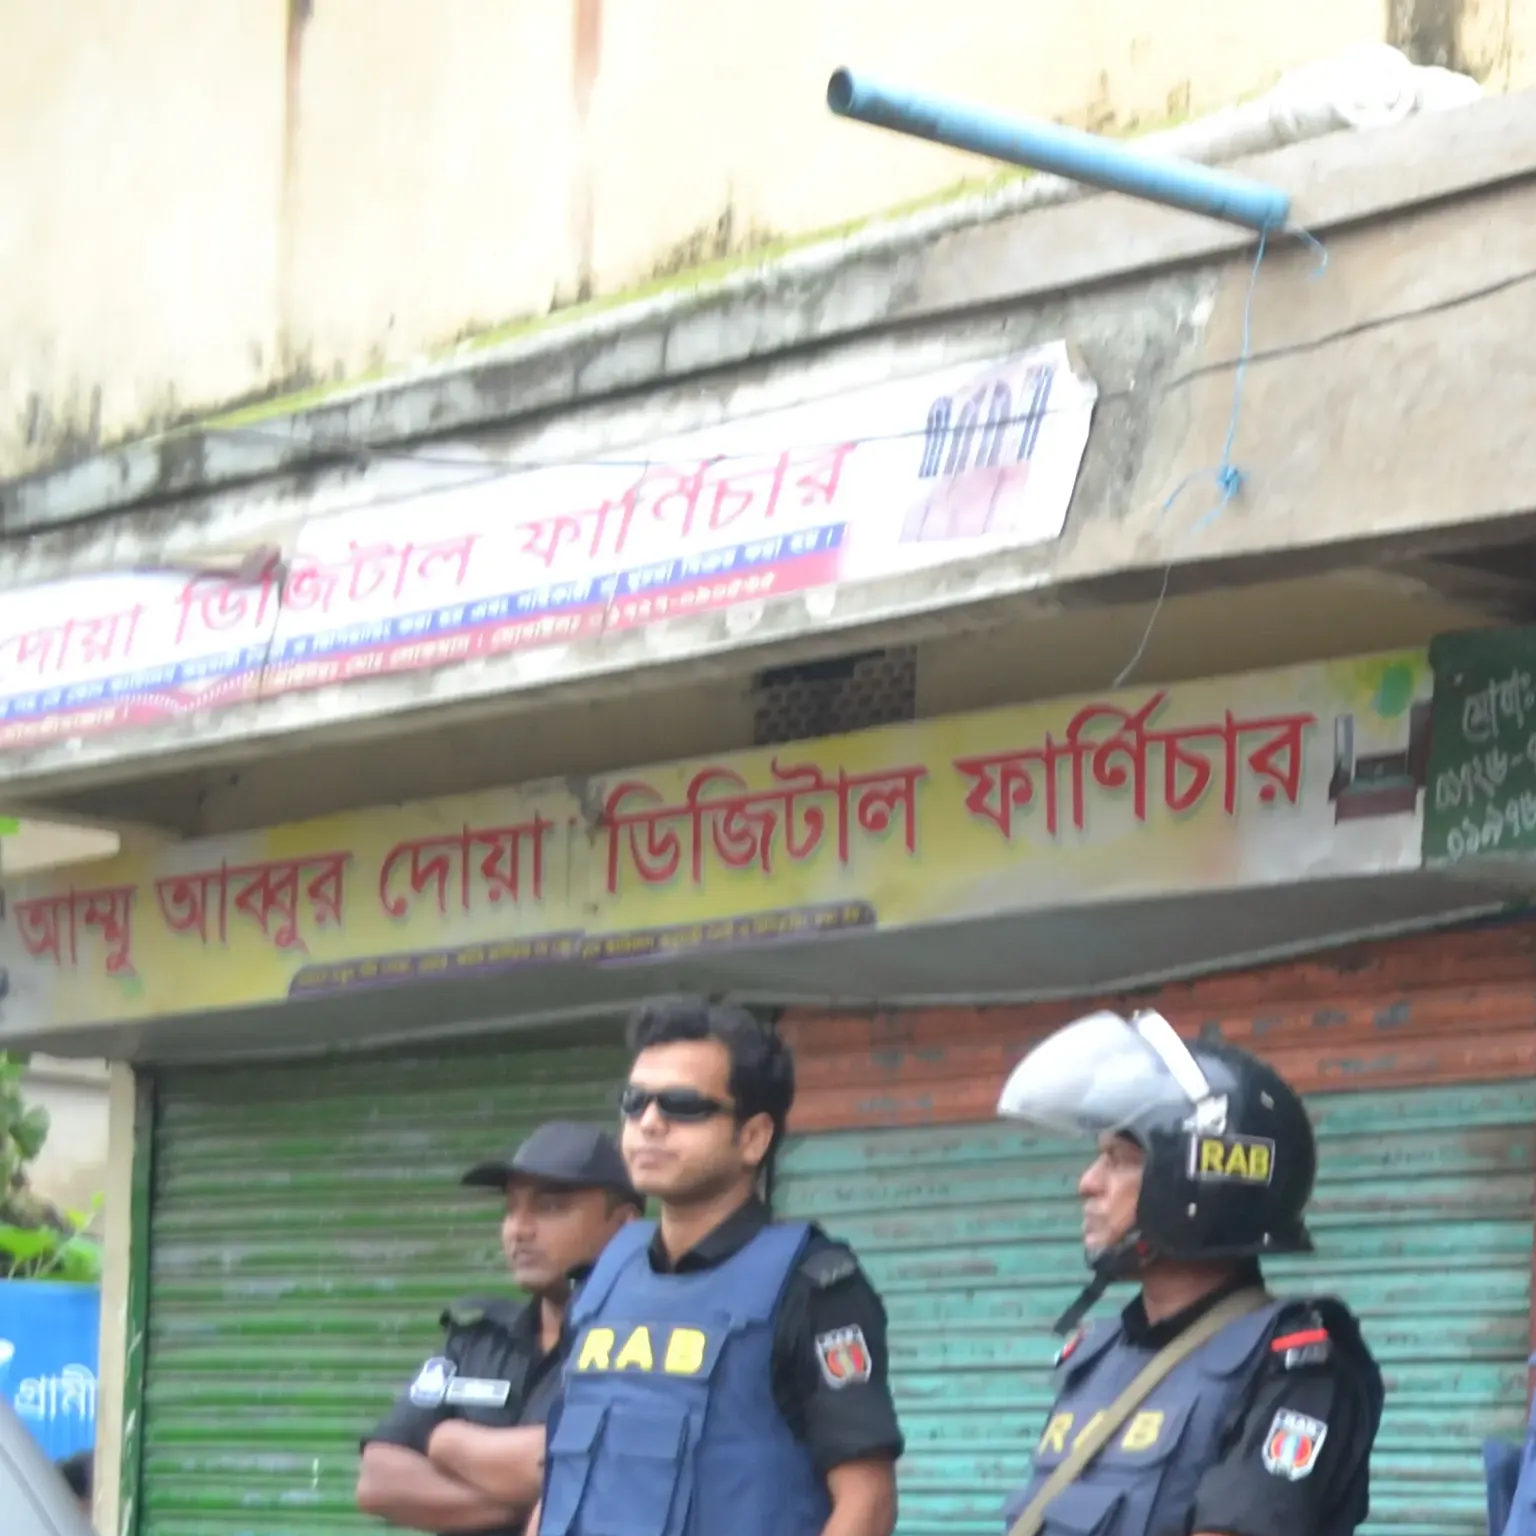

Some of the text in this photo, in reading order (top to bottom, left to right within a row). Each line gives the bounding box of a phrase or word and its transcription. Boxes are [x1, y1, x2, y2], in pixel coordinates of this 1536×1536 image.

[154, 851, 352, 955] আব্বুর
[379, 814, 554, 918] দোয়া
[602, 758, 931, 895] ডিজিটাল
[1200, 1139, 1271, 1180] RAB
[577, 1325, 707, 1375] RAB
